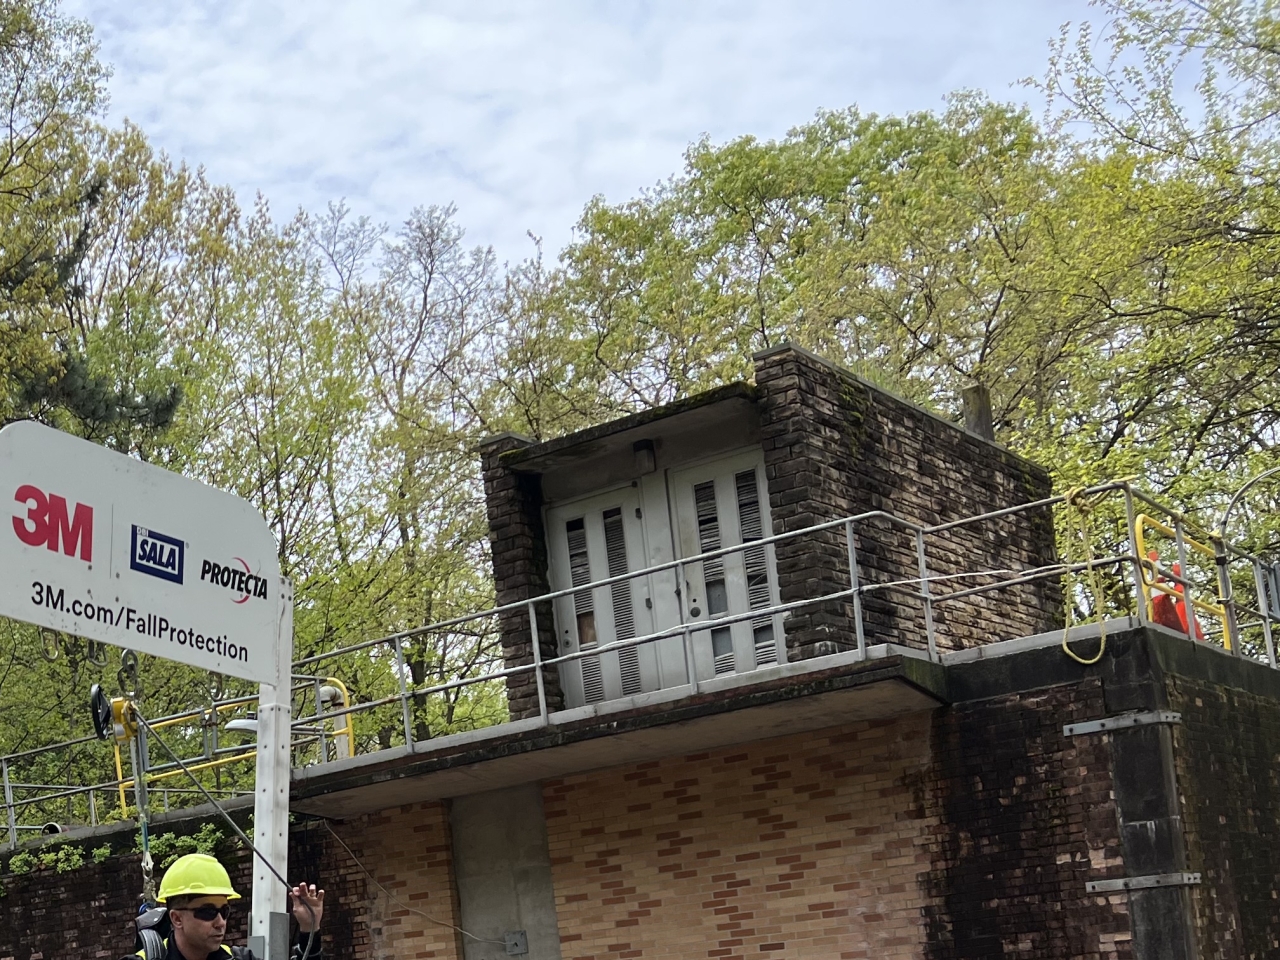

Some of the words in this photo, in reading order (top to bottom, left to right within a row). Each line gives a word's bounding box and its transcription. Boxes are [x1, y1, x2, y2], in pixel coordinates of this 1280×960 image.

[12, 484, 94, 563] 3M
[138, 538, 177, 571] SALA
[200, 559, 268, 600] PROTECTA
[31, 581, 248, 662] 3M.com/FallProtection
